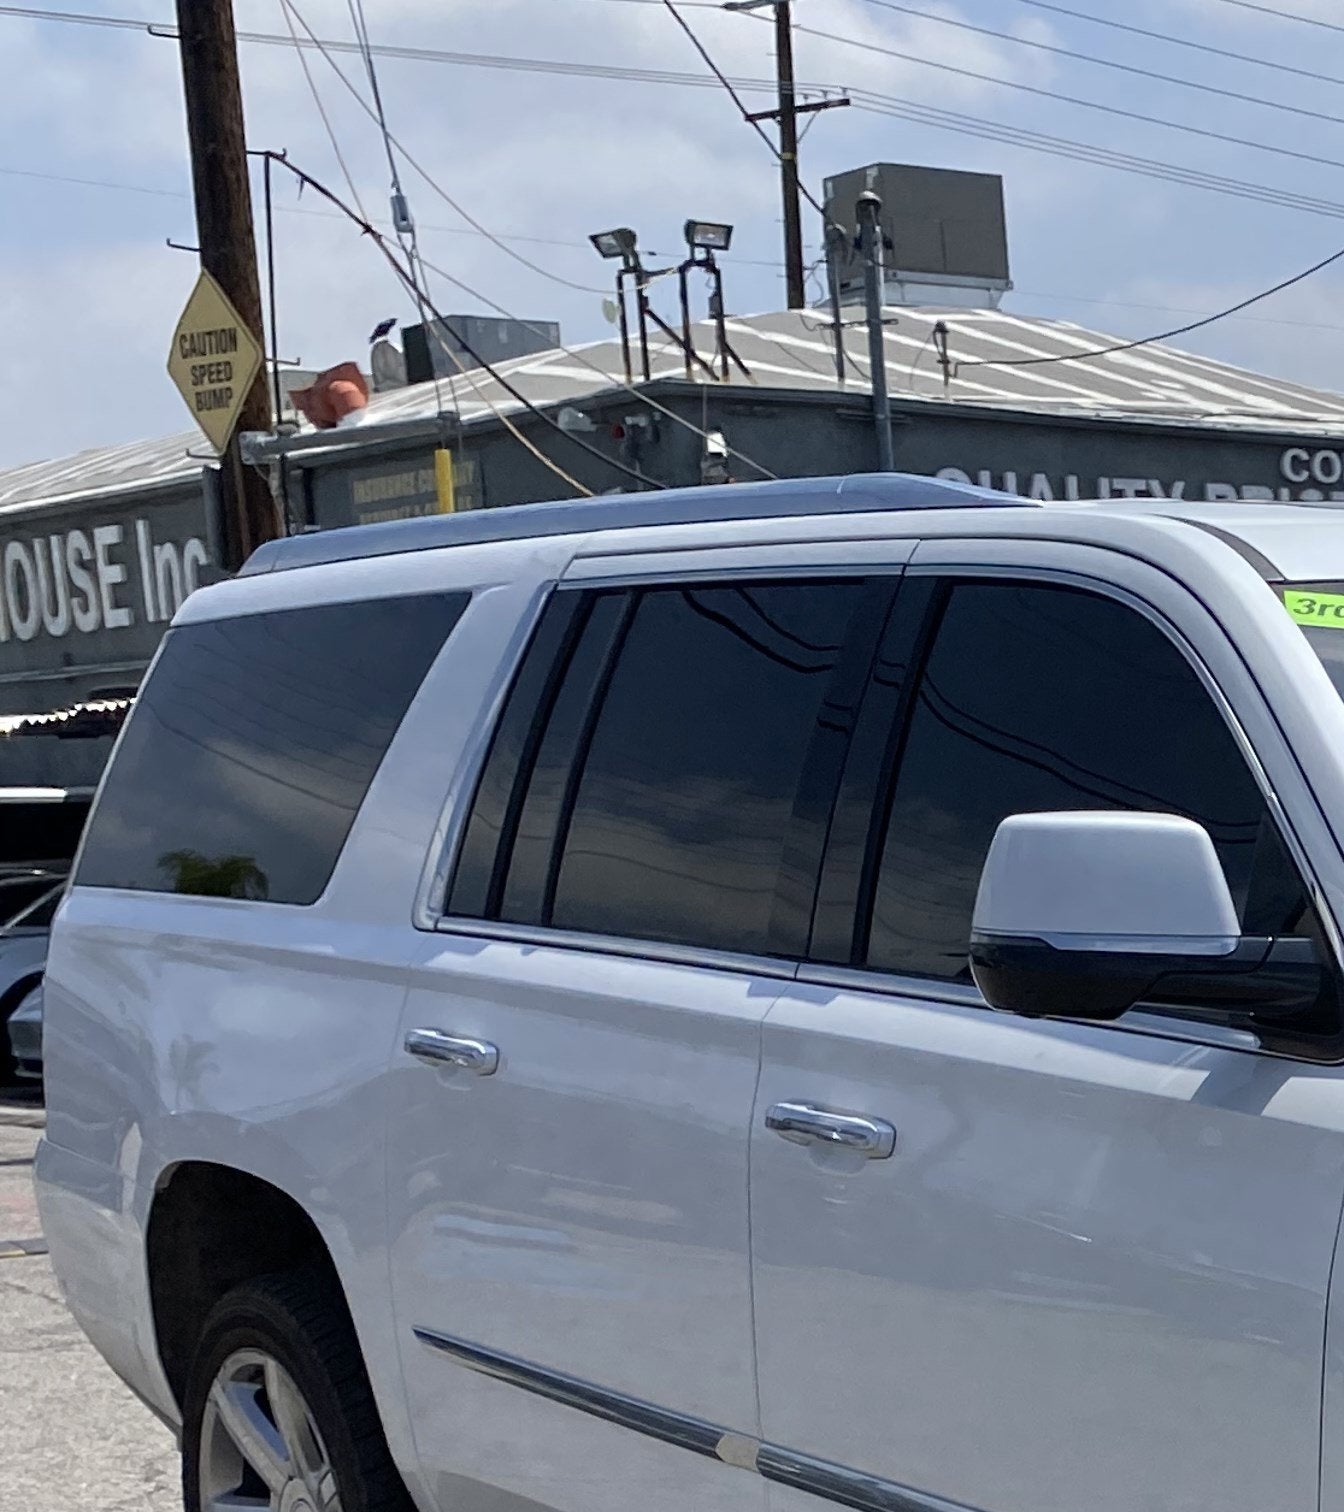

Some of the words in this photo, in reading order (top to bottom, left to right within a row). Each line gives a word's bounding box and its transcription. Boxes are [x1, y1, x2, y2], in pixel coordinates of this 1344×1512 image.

[179, 327, 237, 359] CAUTION
[190, 361, 233, 386] SPEED
[195, 387, 233, 412] BUMP
